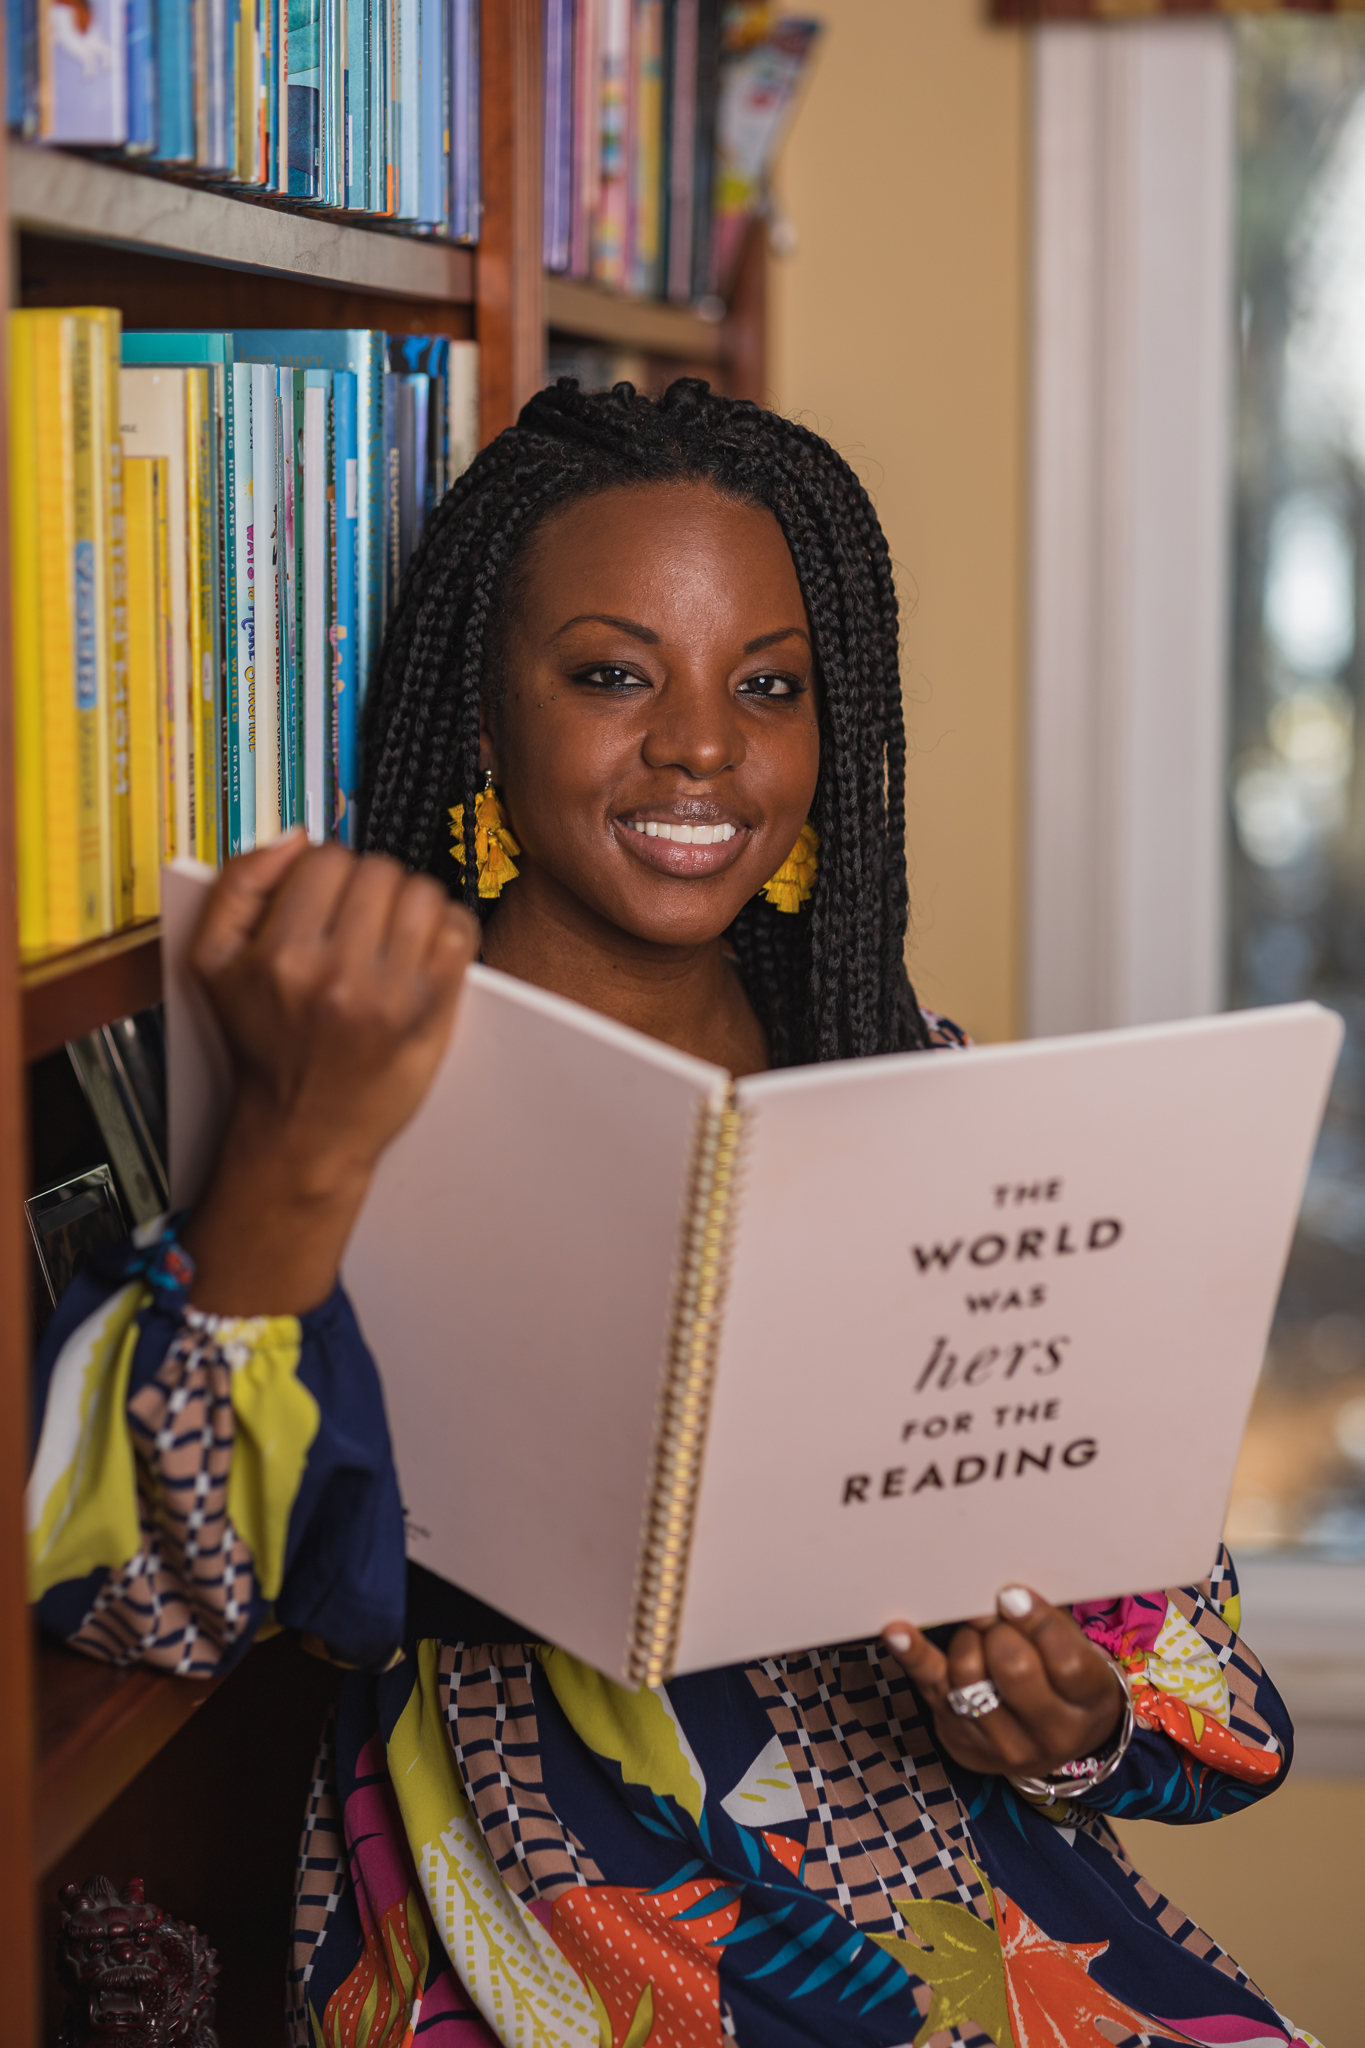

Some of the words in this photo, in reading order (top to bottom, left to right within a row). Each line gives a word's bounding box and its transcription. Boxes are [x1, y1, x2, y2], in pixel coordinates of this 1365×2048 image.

[240, 348, 275, 364] love
[280, 353, 324, 368] story
[993, 1177, 1063, 1208] THE
[910, 1217, 1124, 1275] WORLD
[965, 1284, 1047, 1315] WAS
[913, 1334, 1071, 1394] hers
[900, 1411, 974, 1444] FOR
[992, 1398, 1061, 1428] THE
[841, 1436, 1099, 1506] READING
